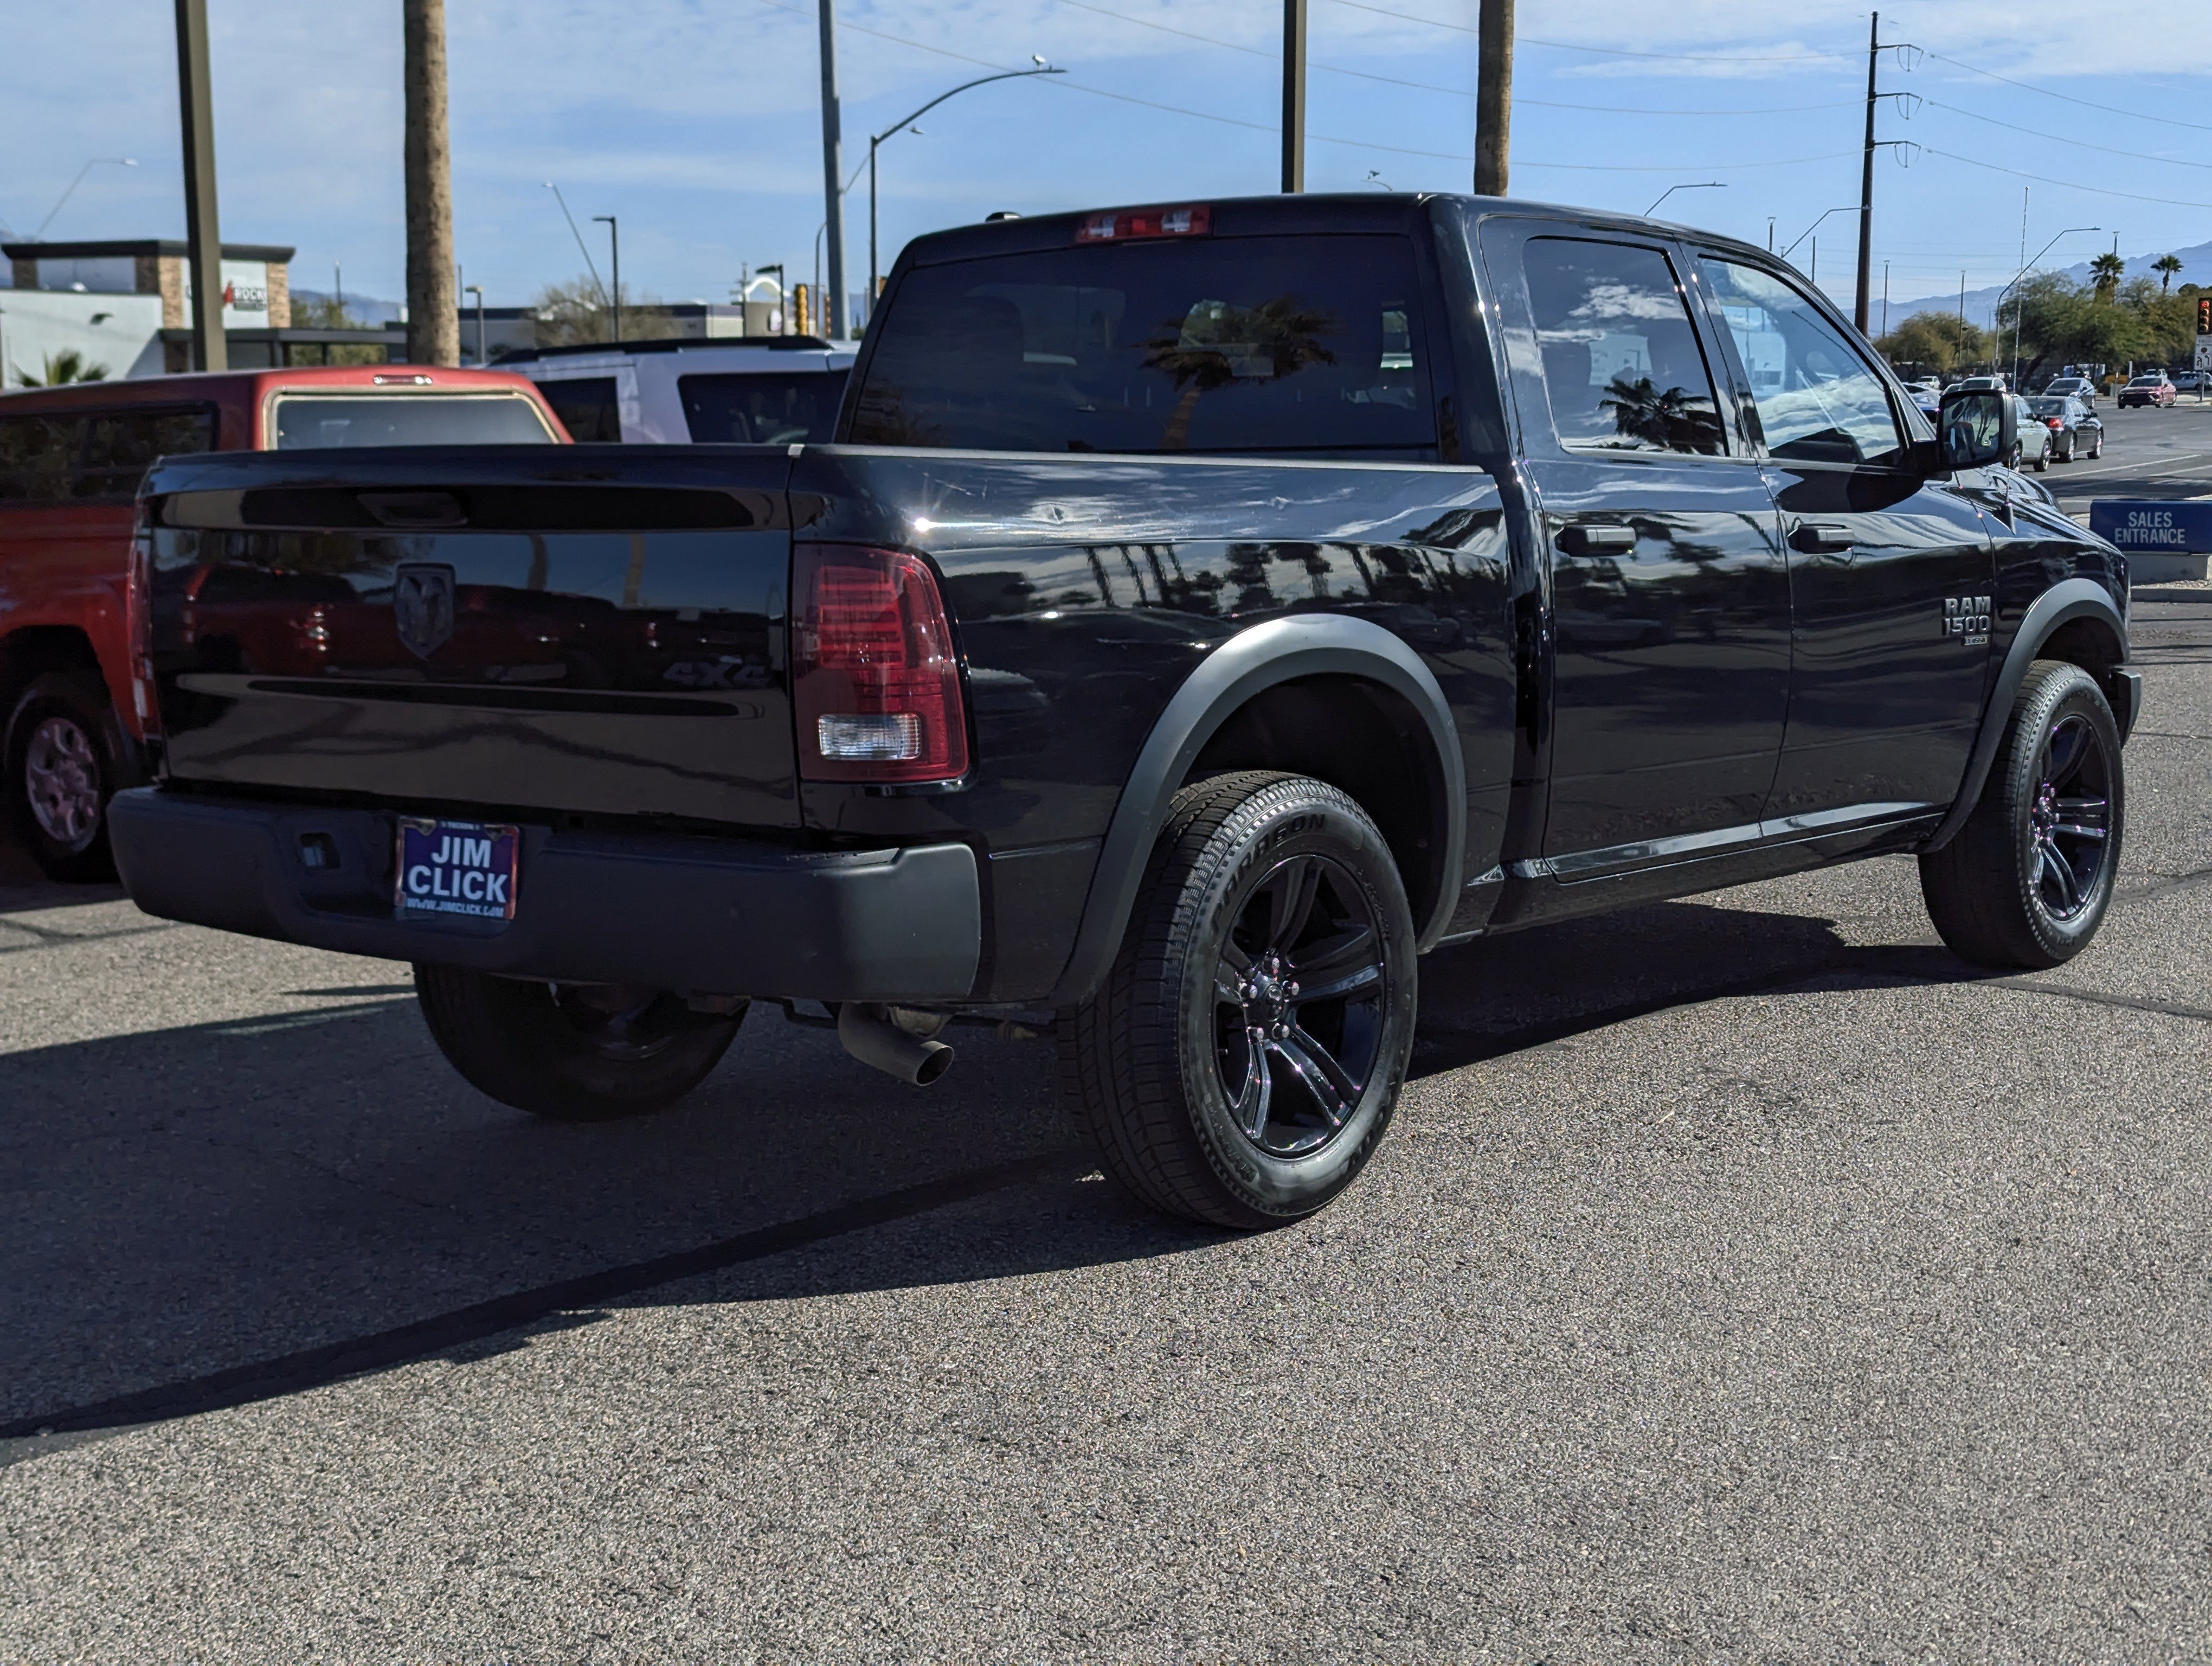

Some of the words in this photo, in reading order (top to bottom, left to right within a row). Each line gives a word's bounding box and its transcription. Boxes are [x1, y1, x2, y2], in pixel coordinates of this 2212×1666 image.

[2129, 511, 2172, 527] SALES
[2115, 528, 2185, 544] ENTRANCE
[1945, 596, 1991, 616] RAM
[1944, 616, 1991, 636] 1500
[431, 835, 491, 868] JIM
[409, 865, 508, 903] CLICK
